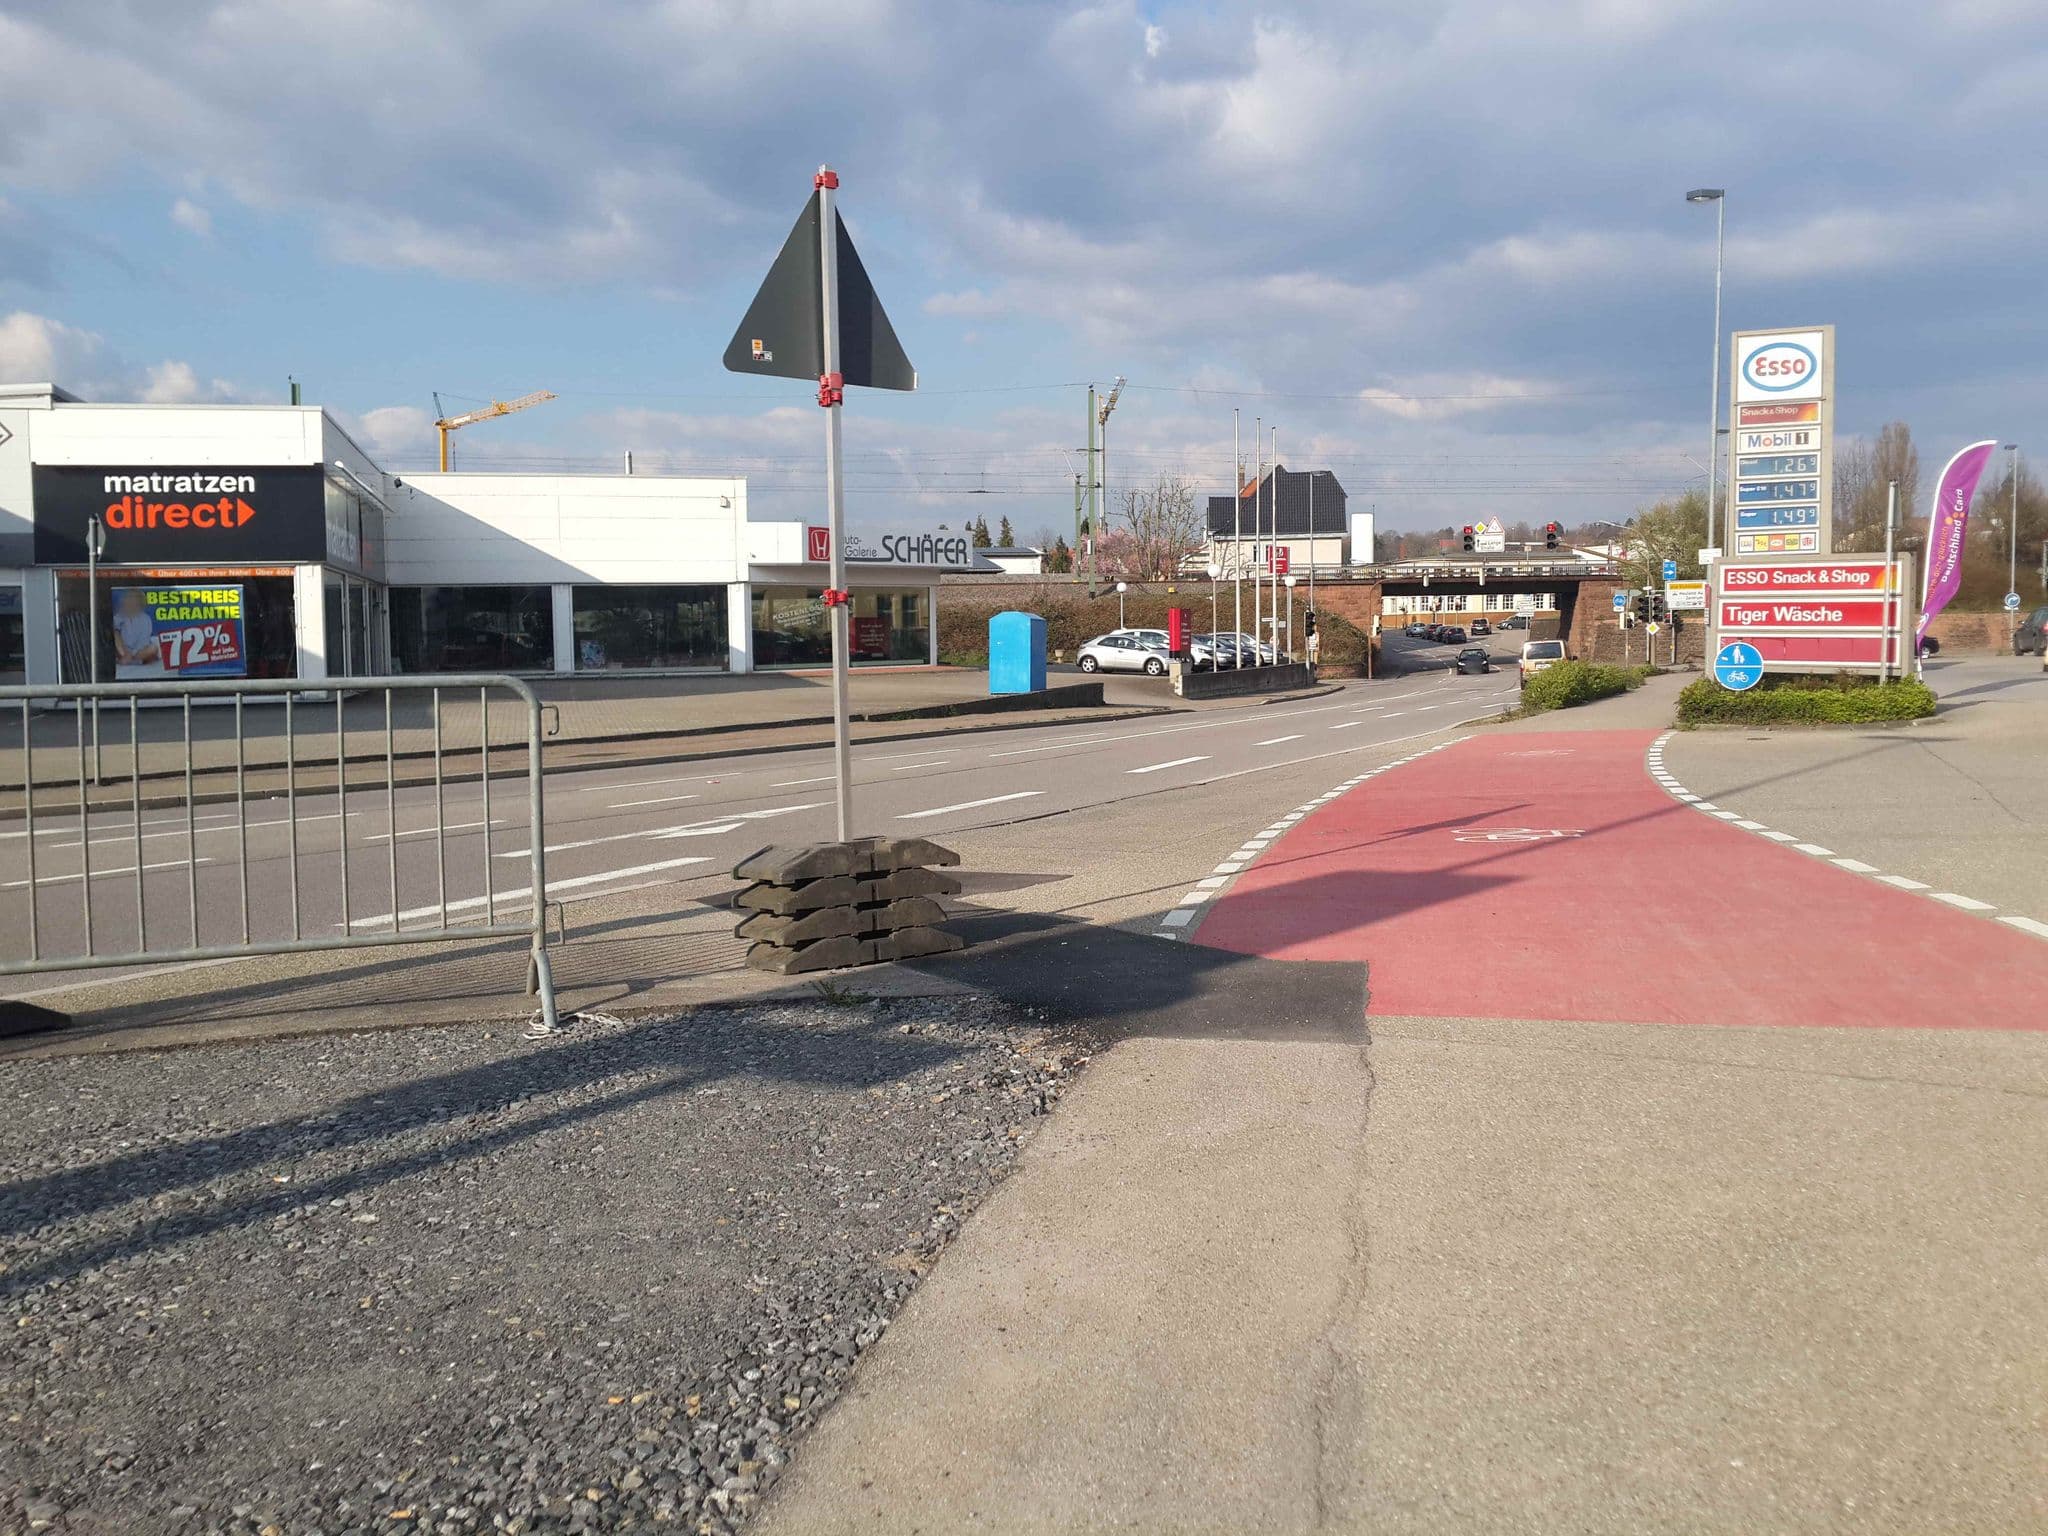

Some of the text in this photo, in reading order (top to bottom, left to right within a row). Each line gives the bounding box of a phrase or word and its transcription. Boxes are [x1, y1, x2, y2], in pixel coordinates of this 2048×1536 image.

[1755, 357, 1805, 376] Esso
[1748, 433, 1791, 448] Mobil
[104, 472, 255, 493] matratzen
[105, 495, 234, 528] direct
[882, 534, 967, 564] SCHÄFER
[1727, 569, 1870, 585] ESSO Snack & Shop
[146, 590, 240, 605] BESTPREIS
[155, 606, 241, 620] GARANTIE
[1727, 606, 1769, 625] Tiger
[1773, 605, 1843, 622] Wäsche
[160, 625, 230, 667] 72%
